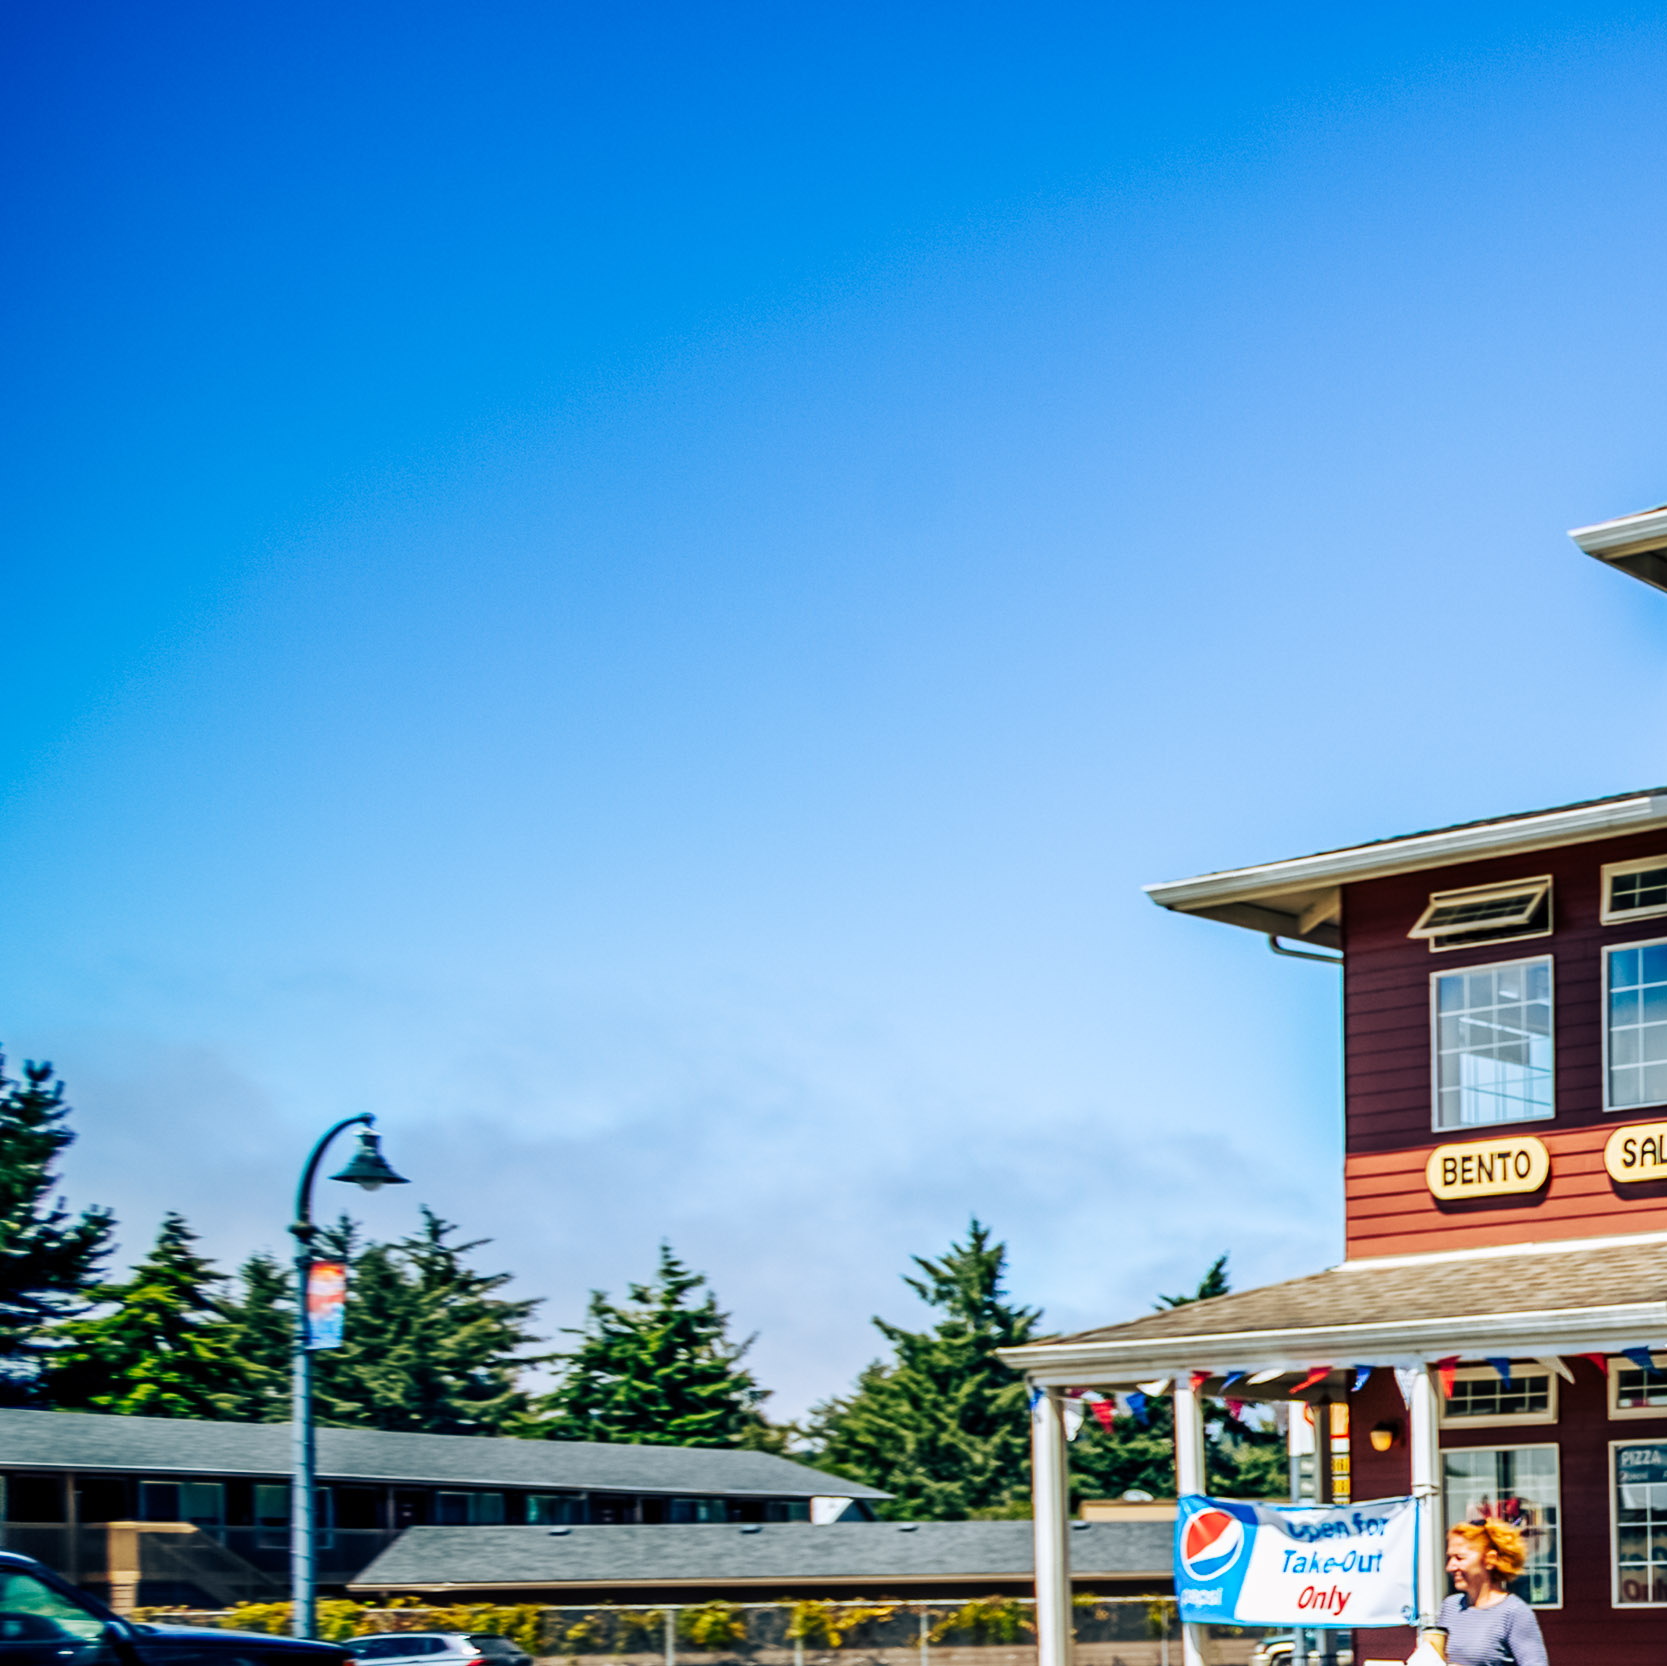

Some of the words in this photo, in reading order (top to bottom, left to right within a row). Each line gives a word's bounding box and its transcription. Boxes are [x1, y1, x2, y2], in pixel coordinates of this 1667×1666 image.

[1442, 1149, 1531, 1187] BENTO
[1621, 1450, 1662, 1467] PIZZA
[1352, 1512, 1390, 1536] for
[1282, 1549, 1383, 1574] Take-Out
[1297, 1584, 1352, 1616] Only
